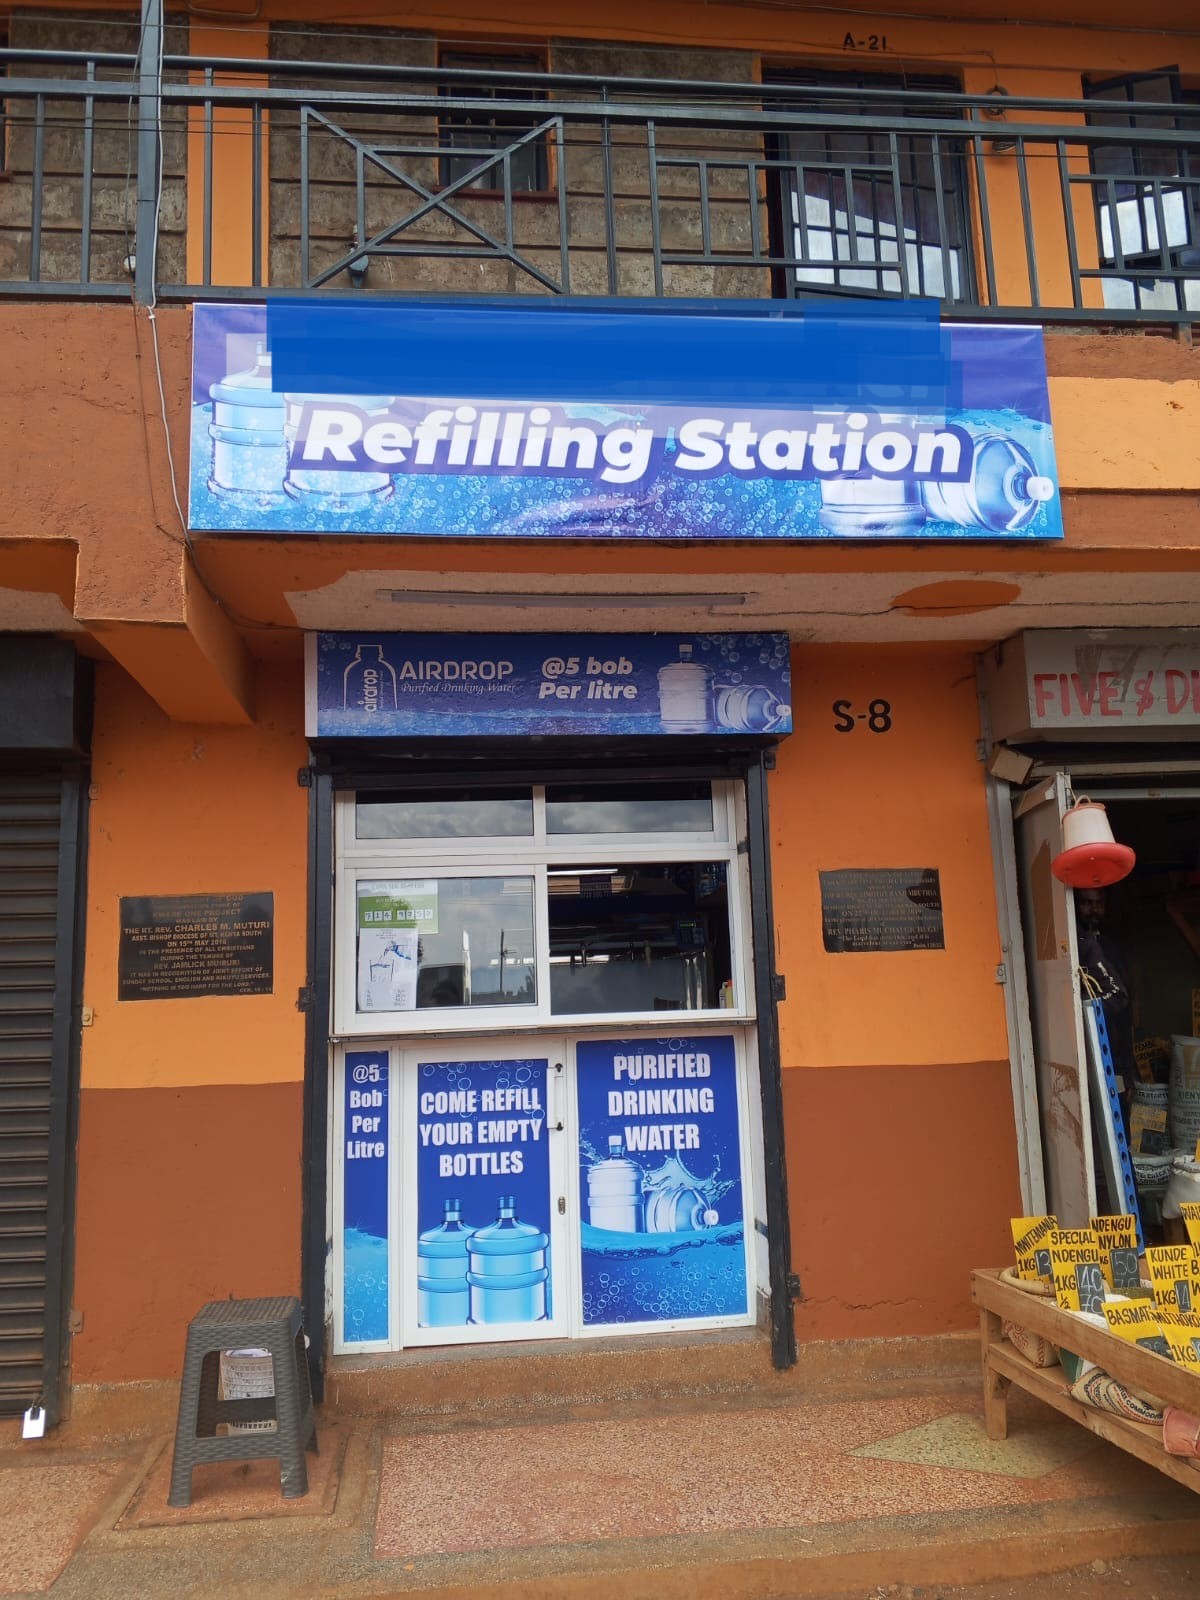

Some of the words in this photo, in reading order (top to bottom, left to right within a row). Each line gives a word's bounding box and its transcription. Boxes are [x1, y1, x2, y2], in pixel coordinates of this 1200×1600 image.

[842, 32, 886, 50] A-21
[302, 406, 652, 484] Refilling
[675, 411, 962, 474] Station
[400, 660, 514, 680] AIRDROP
[542, 657, 580, 679] @5
[586, 656, 633, 675] bob
[358, 668, 379, 712] airdrop
[402, 682, 440, 696] Purified
[442, 682, 484, 696] Drinking
[488, 682, 516, 693] Water
[539, 682, 581, 699] Per
[587, 680, 637, 699] litre
[1034, 671, 1123, 717] FIVE
[832, 699, 892, 733] S-8
[124, 927, 141, 935] THE
[155, 926, 172, 934] REV.
[174, 922, 218, 932] CHARLES
[220, 922, 231, 930] M.
[233, 920, 270, 930] MUTURI
[149, 933, 173, 941] BISHOP
[172, 931, 200, 940] DIOCESE
[241, 929, 263, 937] SOUTH
[160, 947, 194, 955] PRESENCE
[204, 945, 217, 953] ALL
[352, 1064, 380, 1083] @5
[614, 1053, 711, 1081] PURIFIED
[349, 1090, 383, 1109] Bob
[420, 1091, 477, 1115] COME
[481, 1088, 541, 1112] REFILL
[608, 1087, 715, 1117] DRINKING
[351, 1115, 381, 1134] Per
[420, 1122, 474, 1146] YOUR
[478, 1119, 542, 1144] EMPTY
[625, 1124, 700, 1152] WATER
[347, 1139, 385, 1160] Litre
[439, 1151, 524, 1178] BOTTLES
[1091, 1217, 1132, 1233] NDENGU
[1050, 1230, 1097, 1246] SPECIAL
[1098, 1234, 1132, 1250] NYLON
[1018, 1257, 1036, 1272] 1KG
[1035, 1251, 1053, 1276] 13
[1051, 1249, 1099, 1264] NDENGU
[1099, 1255, 1109, 1265] KG
[1150, 1247, 1188, 1263] KUNDE
[1152, 1264, 1188, 1280] WHITE
[1055, 1275, 1077, 1292] 1KG
[1156, 1289, 1176, 1306] 1KG
[1171, 1344, 1198, 1363] 1KG
